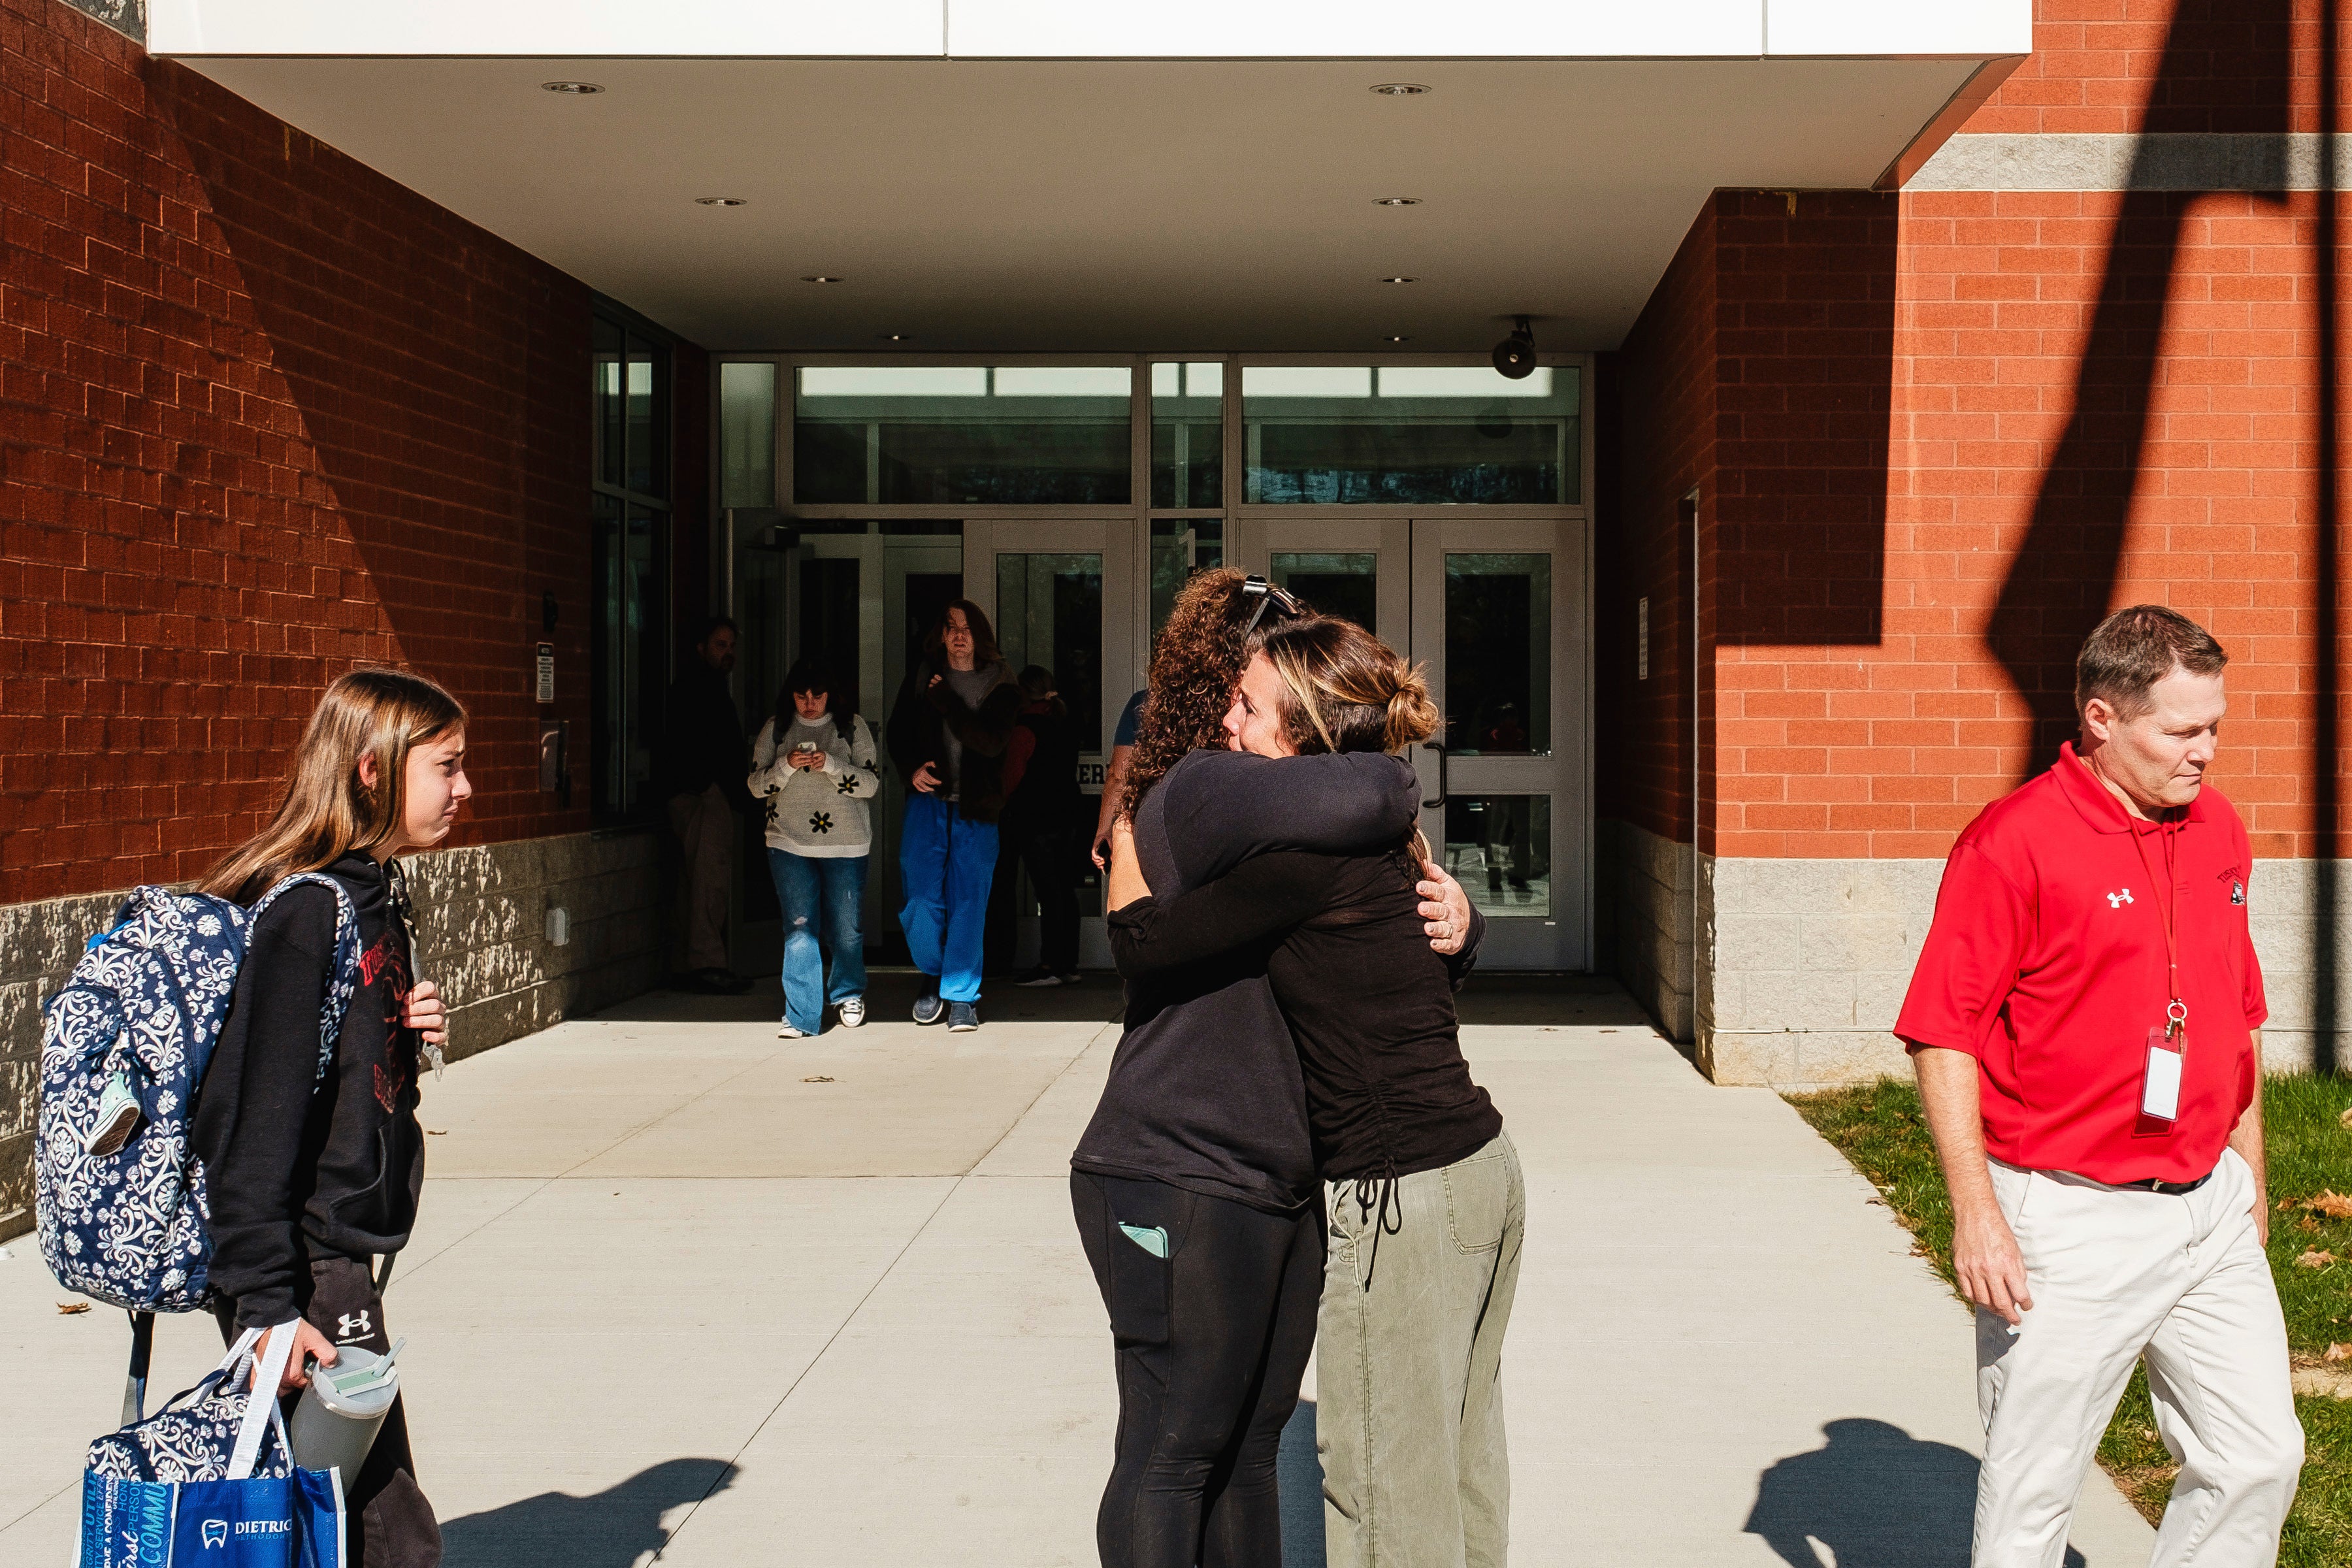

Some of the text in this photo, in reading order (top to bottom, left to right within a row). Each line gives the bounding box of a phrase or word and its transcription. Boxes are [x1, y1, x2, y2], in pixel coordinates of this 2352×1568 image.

[1179, 528, 1196, 568] 1
[1079, 763, 1110, 785] ER
[95, 1502, 104, 1550] SERVICE
[235, 1518, 292, 1535] DIETRIC
[105, 1537, 112, 1546] A
[118, 1531, 139, 1568] irst
